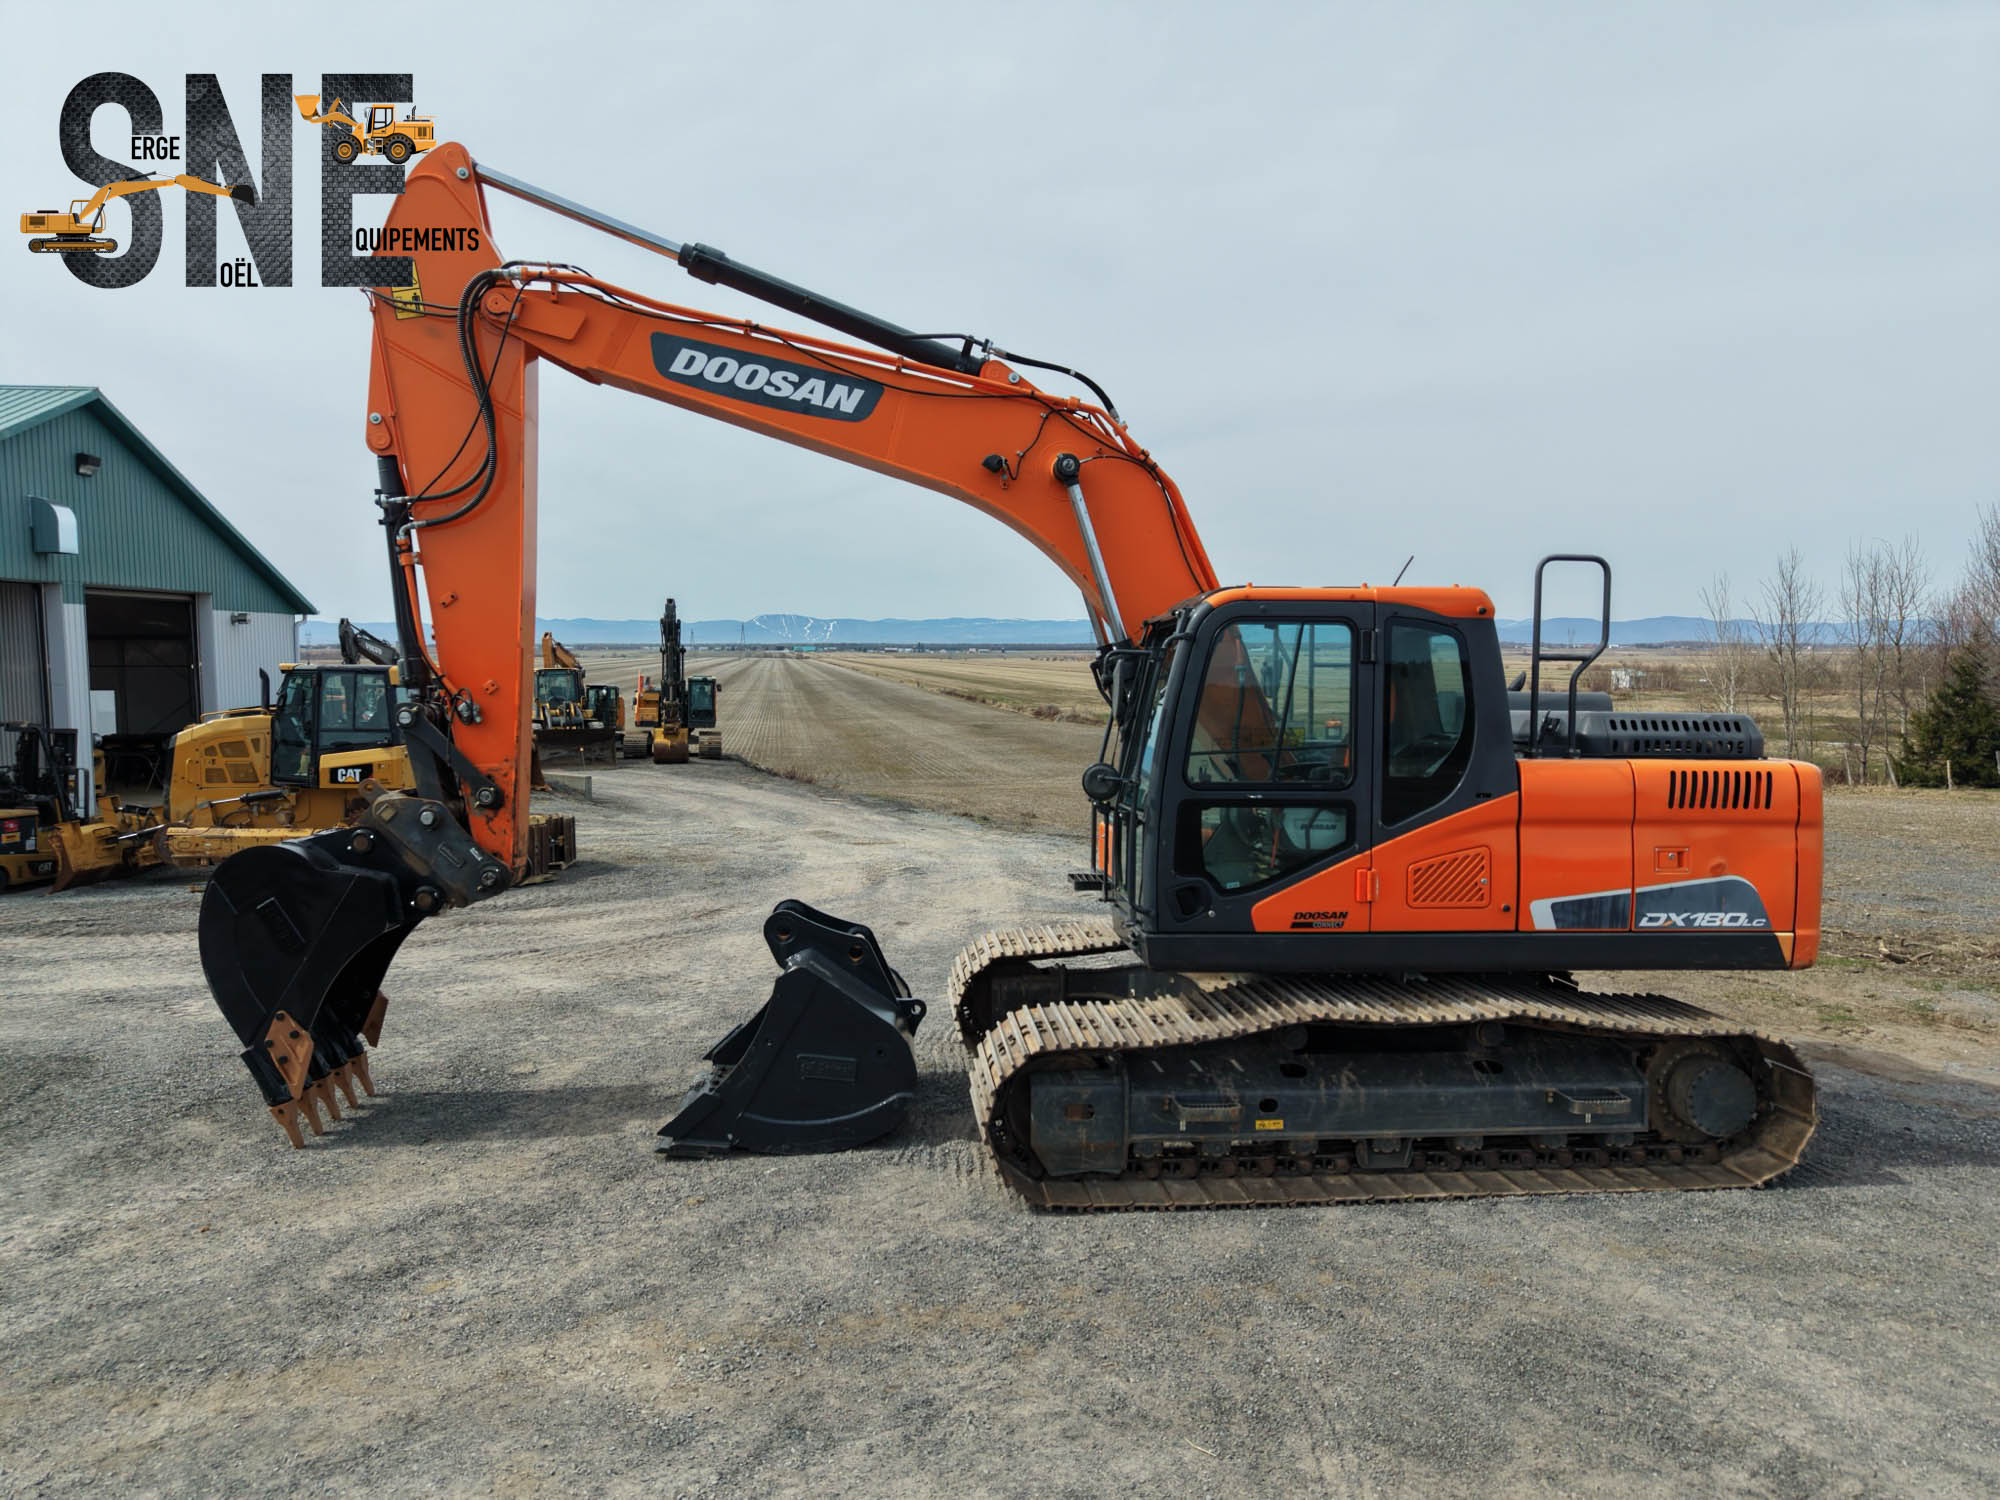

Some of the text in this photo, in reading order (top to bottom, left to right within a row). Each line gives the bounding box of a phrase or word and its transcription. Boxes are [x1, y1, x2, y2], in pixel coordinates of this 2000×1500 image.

[669, 347, 865, 414] DOOSAN
[337, 768, 362, 783] CAT
[1294, 911, 1348, 921] DOOSAN
